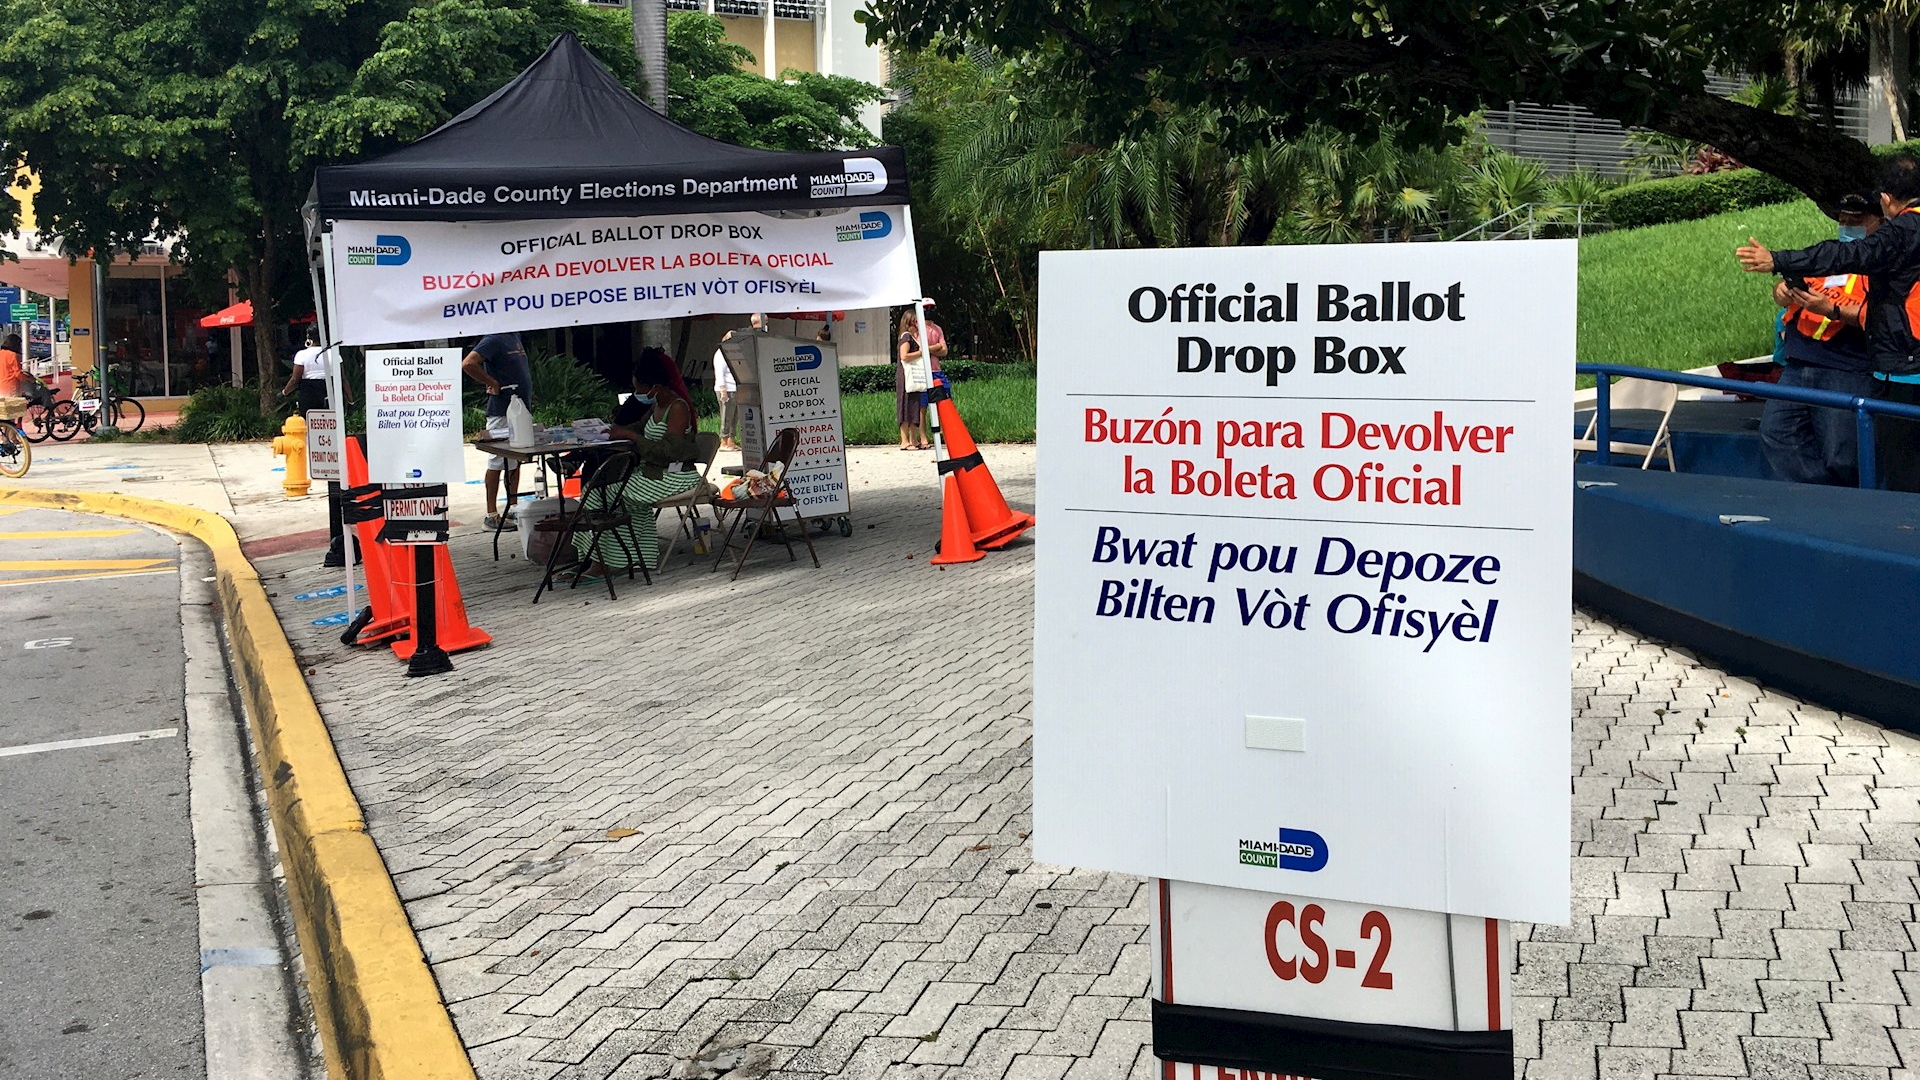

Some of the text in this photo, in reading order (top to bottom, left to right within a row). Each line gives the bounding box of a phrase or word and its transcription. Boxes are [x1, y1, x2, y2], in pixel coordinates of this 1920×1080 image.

[810, 171, 874, 185] MIAMI-DADE
[350, 173, 798, 207] Miami-Dade County Elections Department
[811, 186, 845, 197] COUNTY
[835, 221, 882, 232] MIAMI-DADE
[501, 223, 763, 255] OFFICIAL BALLOT DROP BOX
[837, 232, 862, 241] COUNTY
[348, 245, 400, 255] MIAMI-DADE
[349, 256, 375, 265] COUNTY
[423, 252, 834, 291] BUZÓN PARA DEVOLVER LA BOLETA OFICIAL
[443, 277, 822, 318] BWAT POU DEPOSE BILTEN VÒT OFISYÈL
[1128, 281, 1466, 323] Official Ballot
[382, 356, 443, 366] Official Ballot
[1177, 336, 1407, 387] Drop Box
[392, 367, 434, 378] Drop Box
[774, 364, 795, 372] COUNTY
[780, 376, 821, 387] OFFICIAL
[375, 382, 452, 394] Buzón para Devolver
[784, 387, 818, 398] BALLOT
[382, 392, 444, 402] la Boleta Oficial
[779, 398, 825, 410] DROP BOX
[377, 408, 451, 420] Bwat pou Depoze
[310, 419, 337, 430] RESERVED
[378, 419, 451, 431] Bilten Vòt Ofisyèl
[809, 423, 834, 433] PARA
[1084, 406, 1514, 459] Buzón para Devolver
[318, 435, 332, 447] CS-6
[800, 434, 836, 446] LVER LA
[807, 445, 843, 456] OFICIAL
[311, 451, 339, 463] PERMIT ONLY
[813, 472, 832, 482] POU
[1124, 455, 1462, 506] la Boleta Oficial
[793, 482, 843, 496] OZE BILTEN
[802, 493, 840, 506] OFISYÈL
[390, 499, 418, 517] PERMIT
[1092, 525, 1501, 593] Bwat pou Depoze
[1095, 578, 1499, 653] Bilten Vòt Ofisyèl
[1239, 838, 1312, 857] MIAMI-DADE
[1240, 852, 1277, 866] COUNTY
[1264, 900, 1394, 990] CS-2
